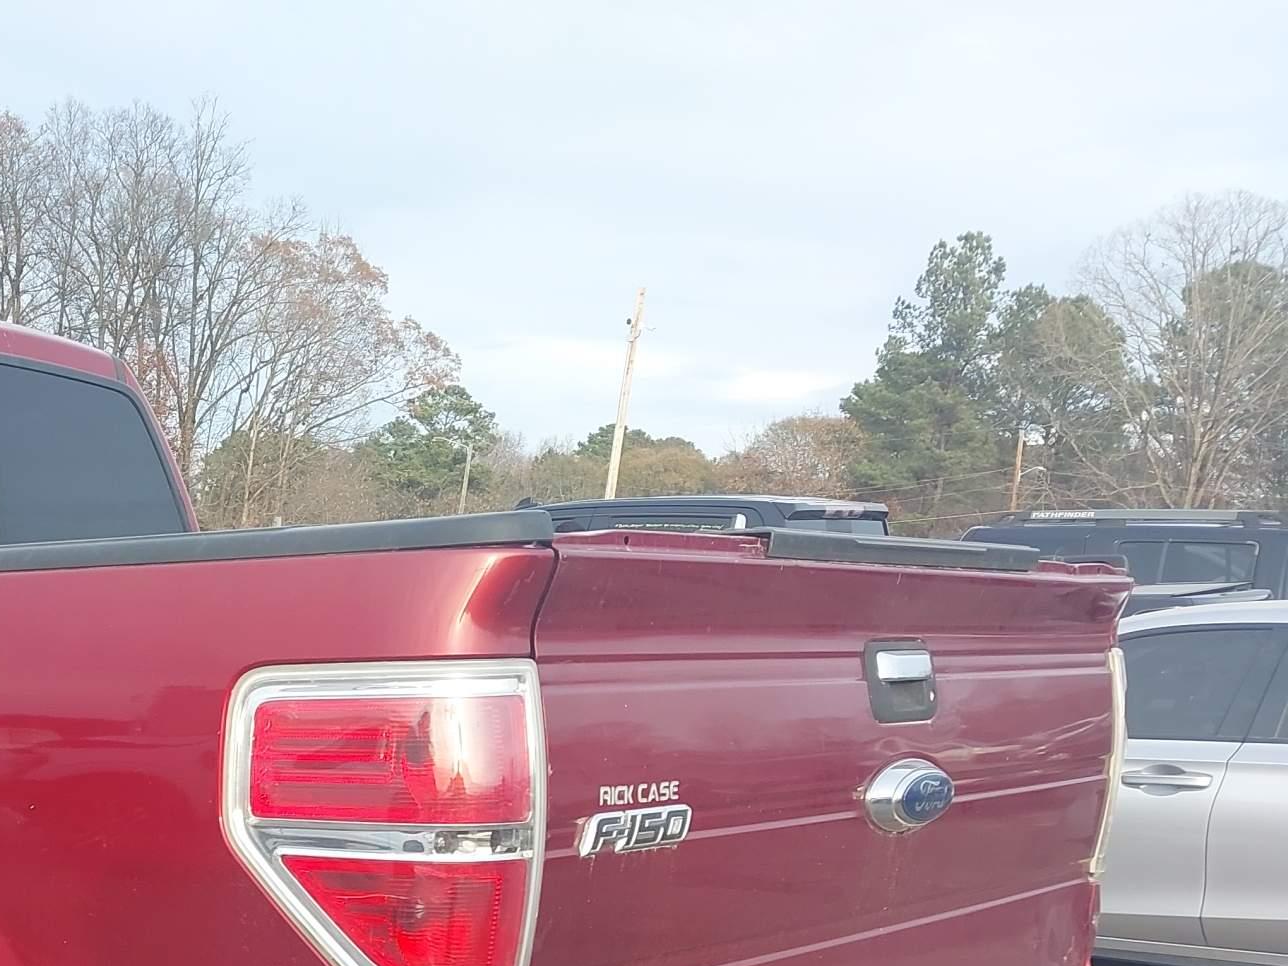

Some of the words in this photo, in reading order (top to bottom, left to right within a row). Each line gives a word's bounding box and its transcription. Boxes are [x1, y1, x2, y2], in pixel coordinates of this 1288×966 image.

[1030, 510, 1097, 519] PATHFINDER
[599, 784, 634, 806] RICK
[637, 780, 680, 804] CASE
